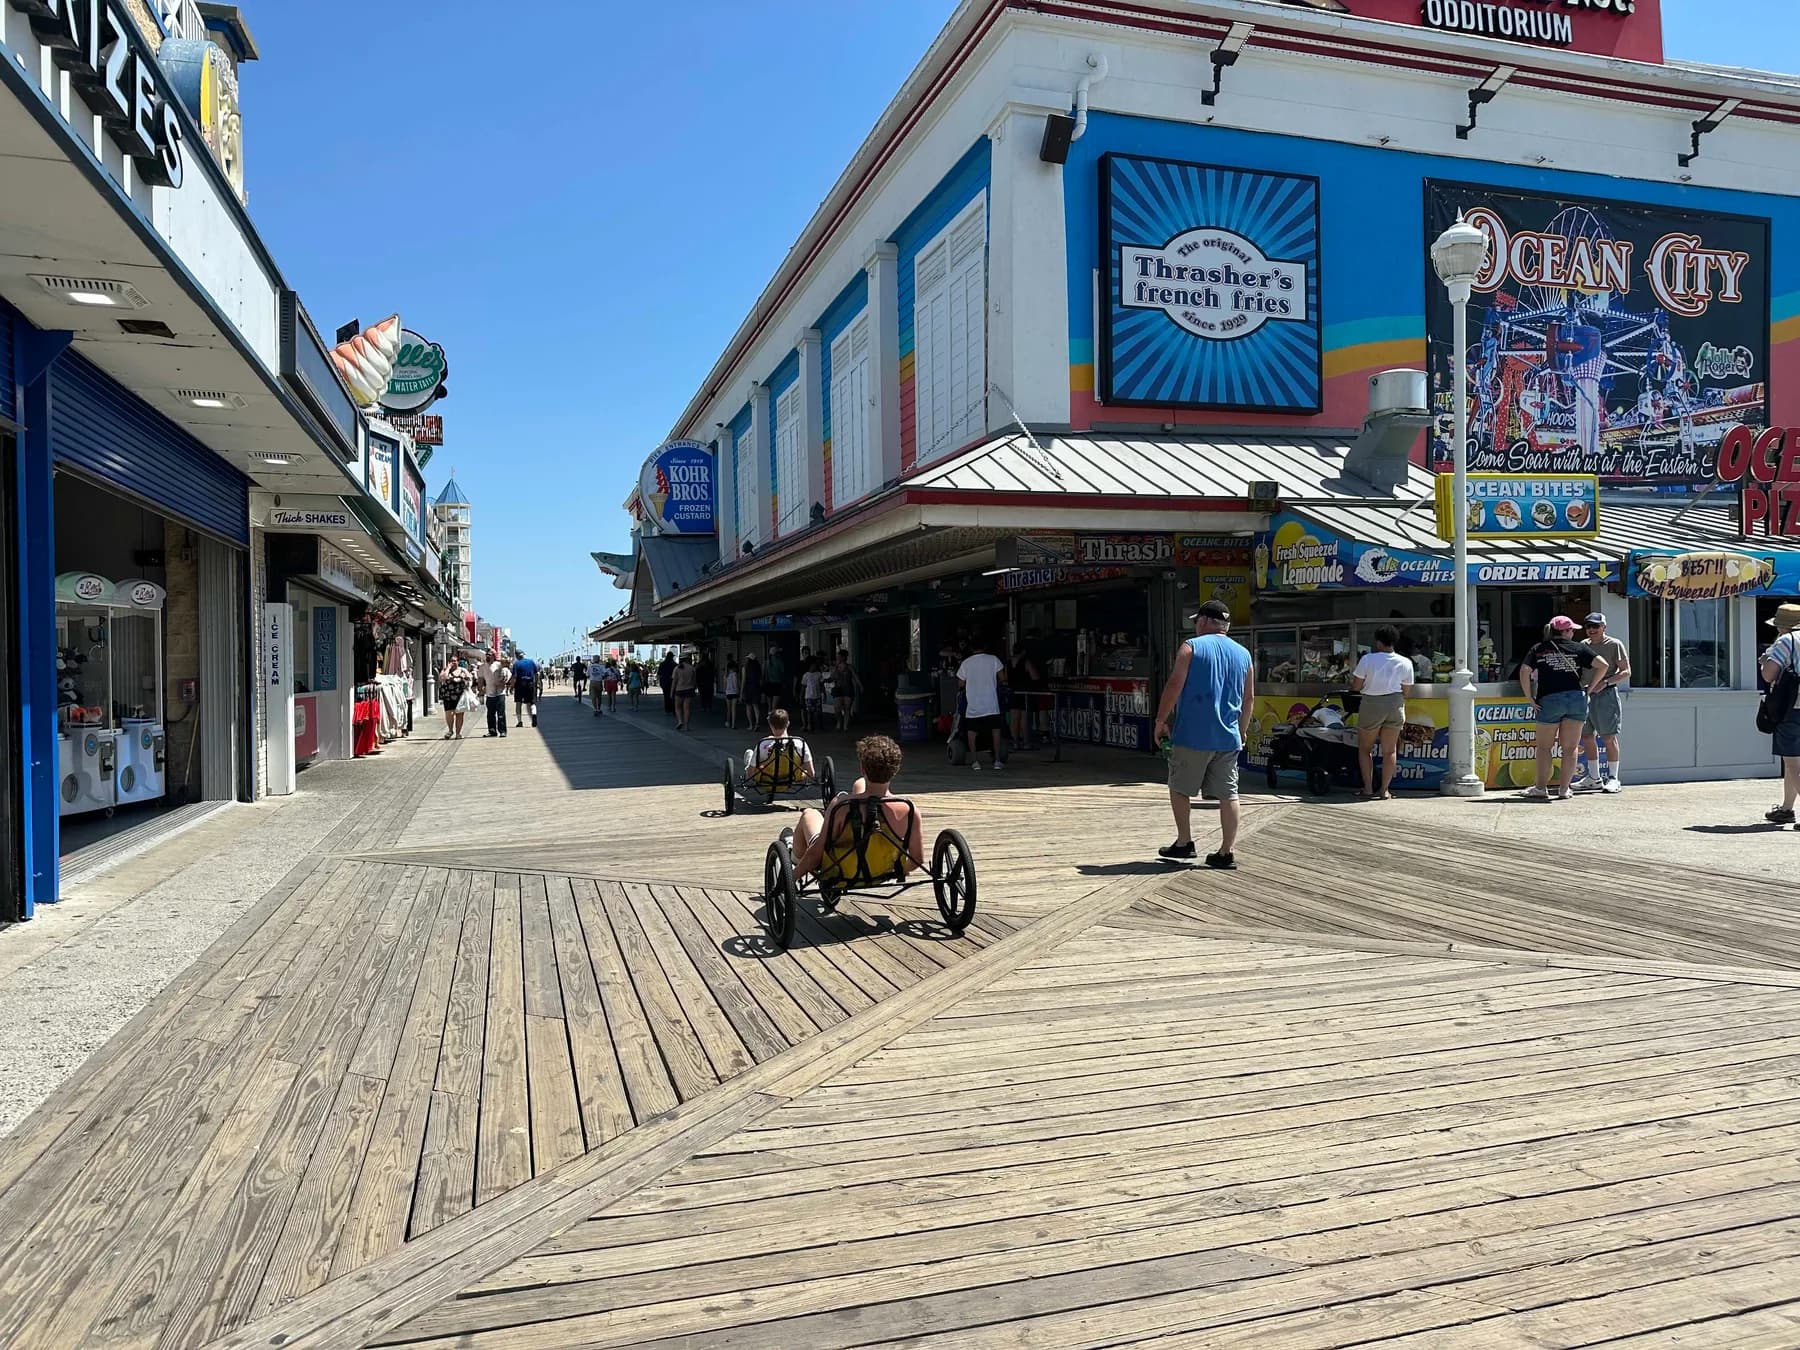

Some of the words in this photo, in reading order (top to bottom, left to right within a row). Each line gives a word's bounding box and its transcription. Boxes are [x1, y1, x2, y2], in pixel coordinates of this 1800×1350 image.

[1427, 0, 1573, 43] ODDITORIUM
[50, 0, 184, 189] IZES
[1177, 244, 1200, 258] The
[1203, 237, 1252, 265] original
[1133, 254, 1294, 291] Thrasher's
[1463, 207, 1633, 294] OCEAN
[1644, 232, 1749, 317] CITY
[1134, 281, 1221, 309] french
[1231, 288, 1292, 316] fries
[1182, 311, 1217, 331] since
[1220, 313, 1248, 332] 1929
[397, 343, 444, 369] lle's
[394, 380, 418, 393] WATER
[418, 375, 436, 389] TAFFY
[1466, 439, 1505, 470] Come
[1507, 440, 1551, 472] Soar
[1553, 446, 1581, 472] with
[1583, 454, 1600, 473] us
[1601, 450, 1616, 473] at
[1622, 449, 1643, 475] the
[1645, 448, 1699, 478] Eastern
[668, 465, 710, 483] KOHR
[671, 484, 709, 501] BROS
[1466, 481, 1526, 497] OCEAN
[1531, 482, 1585, 497] BITES
[274, 511, 304, 524] Thick
[305, 513, 346, 525] SHAKES
[673, 512, 711, 520] CUSTARD
[679, 504, 711, 512] FROZEN
[1080, 536, 1175, 563] Thrash
[1276, 545, 1298, 562] Fresh
[1299, 540, 1339, 561] Squeezed
[1282, 562, 1344, 586] Lemonade
[1400, 559, 1441, 572] OCEAN
[1478, 565, 1539, 581] ORDER
[1544, 565, 1591, 580] HERE
[1681, 558, 1724, 577] BEST!!
[1420, 571, 1456, 583] BITES
[1640, 573, 1665, 598] Fresh
[1667, 578, 1716, 599] Squeezed
[1719, 569, 1770, 597] Lemonade
[271, 616, 279, 639] ICE
[271, 645, 280, 685] CREAM
[1104, 684, 1150, 715] french
[1477, 706, 1516, 721] OCEAN
[1105, 713, 1139, 748] fries
[1493, 729, 1517, 741] Fresh
[1404, 743, 1449, 759] Pulled
[1501, 742, 1563, 760] Lemode
[1393, 764, 1425, 779] Pork
